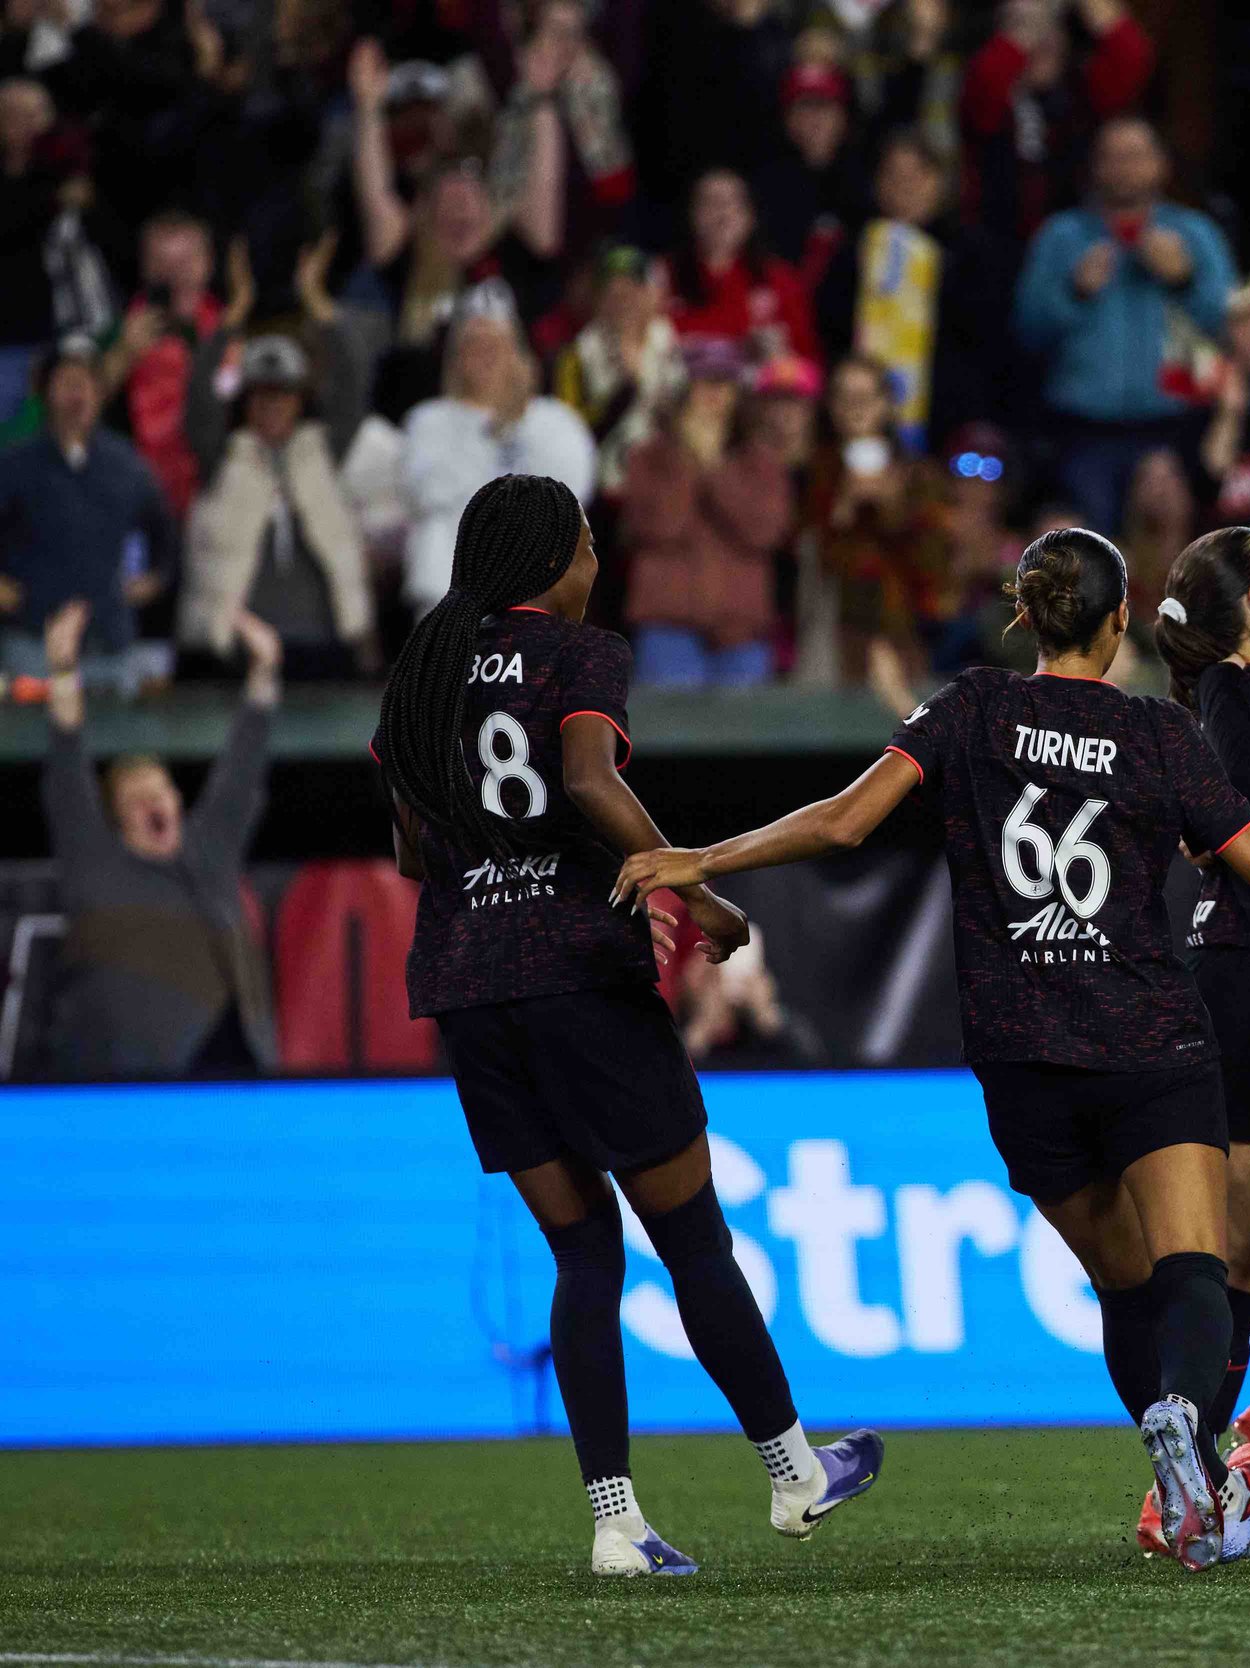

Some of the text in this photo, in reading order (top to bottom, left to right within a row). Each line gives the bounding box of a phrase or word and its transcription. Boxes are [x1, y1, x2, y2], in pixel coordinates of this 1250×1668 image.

[467, 652, 523, 684] BOA
[478, 711, 547, 819] 8
[1014, 724, 1117, 775] TURNER
[1001, 782, 1111, 919] 66
[1021, 949, 1113, 964] AIRLINE
